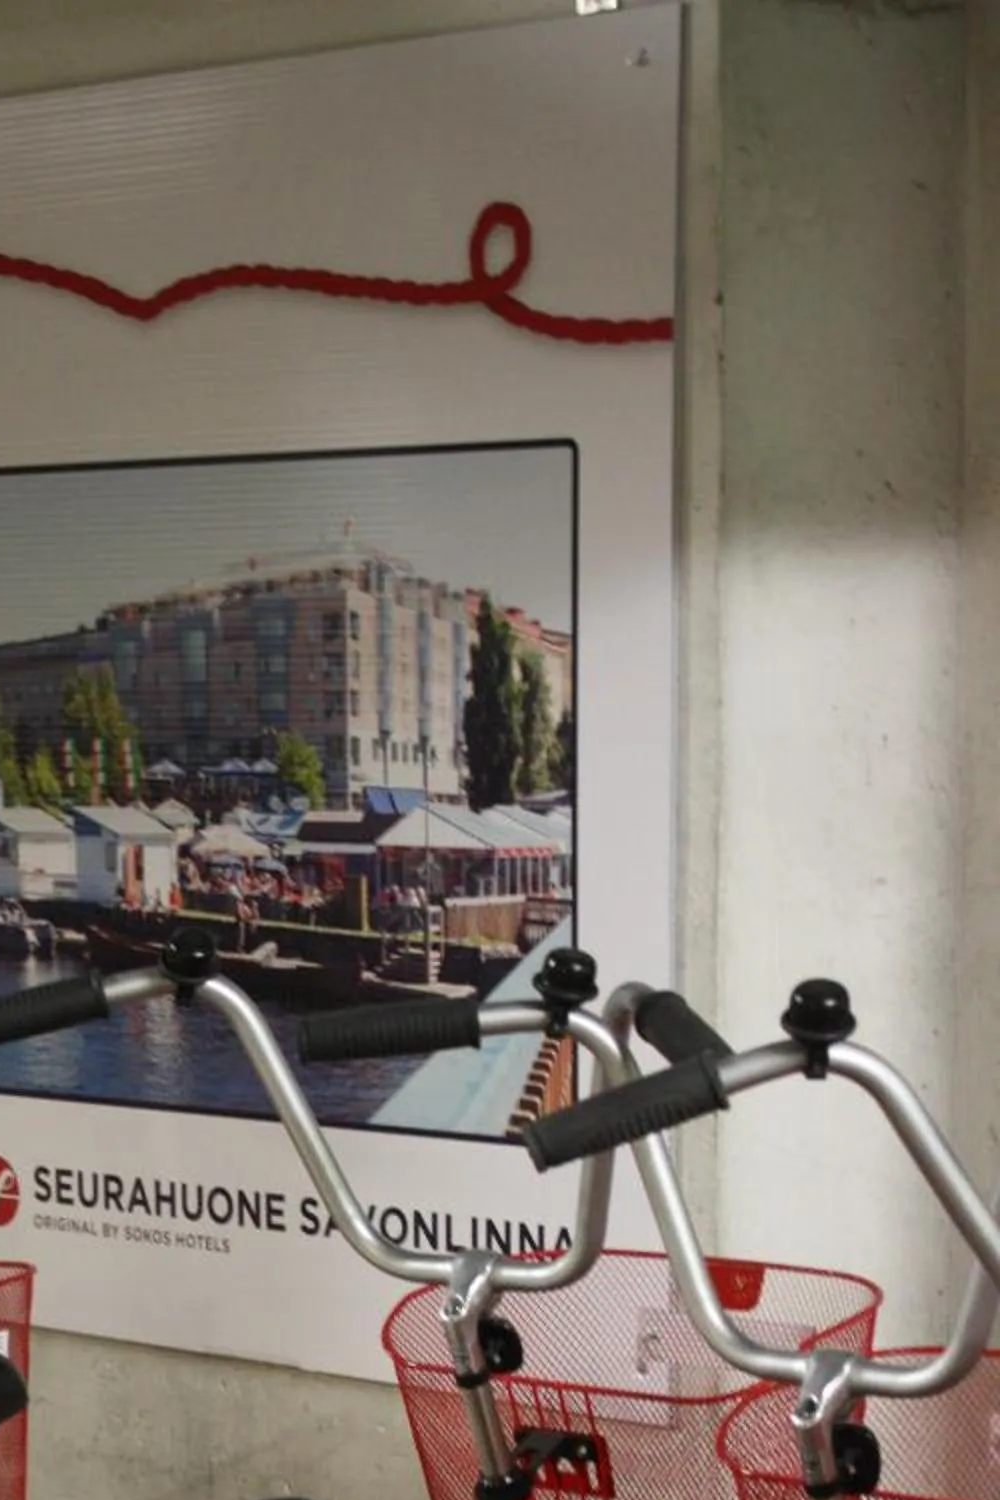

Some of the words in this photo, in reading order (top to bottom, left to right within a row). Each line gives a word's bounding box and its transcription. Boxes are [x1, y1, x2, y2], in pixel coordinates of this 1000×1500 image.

[33, 1166, 287, 1233] SEURAHUONE
[33, 1214, 98, 1237] ORIGINAL
[102, 1224, 119, 1239] BY
[125, 1227, 172, 1247] SOKOS
[175, 1234, 231, 1254] HOTELS
